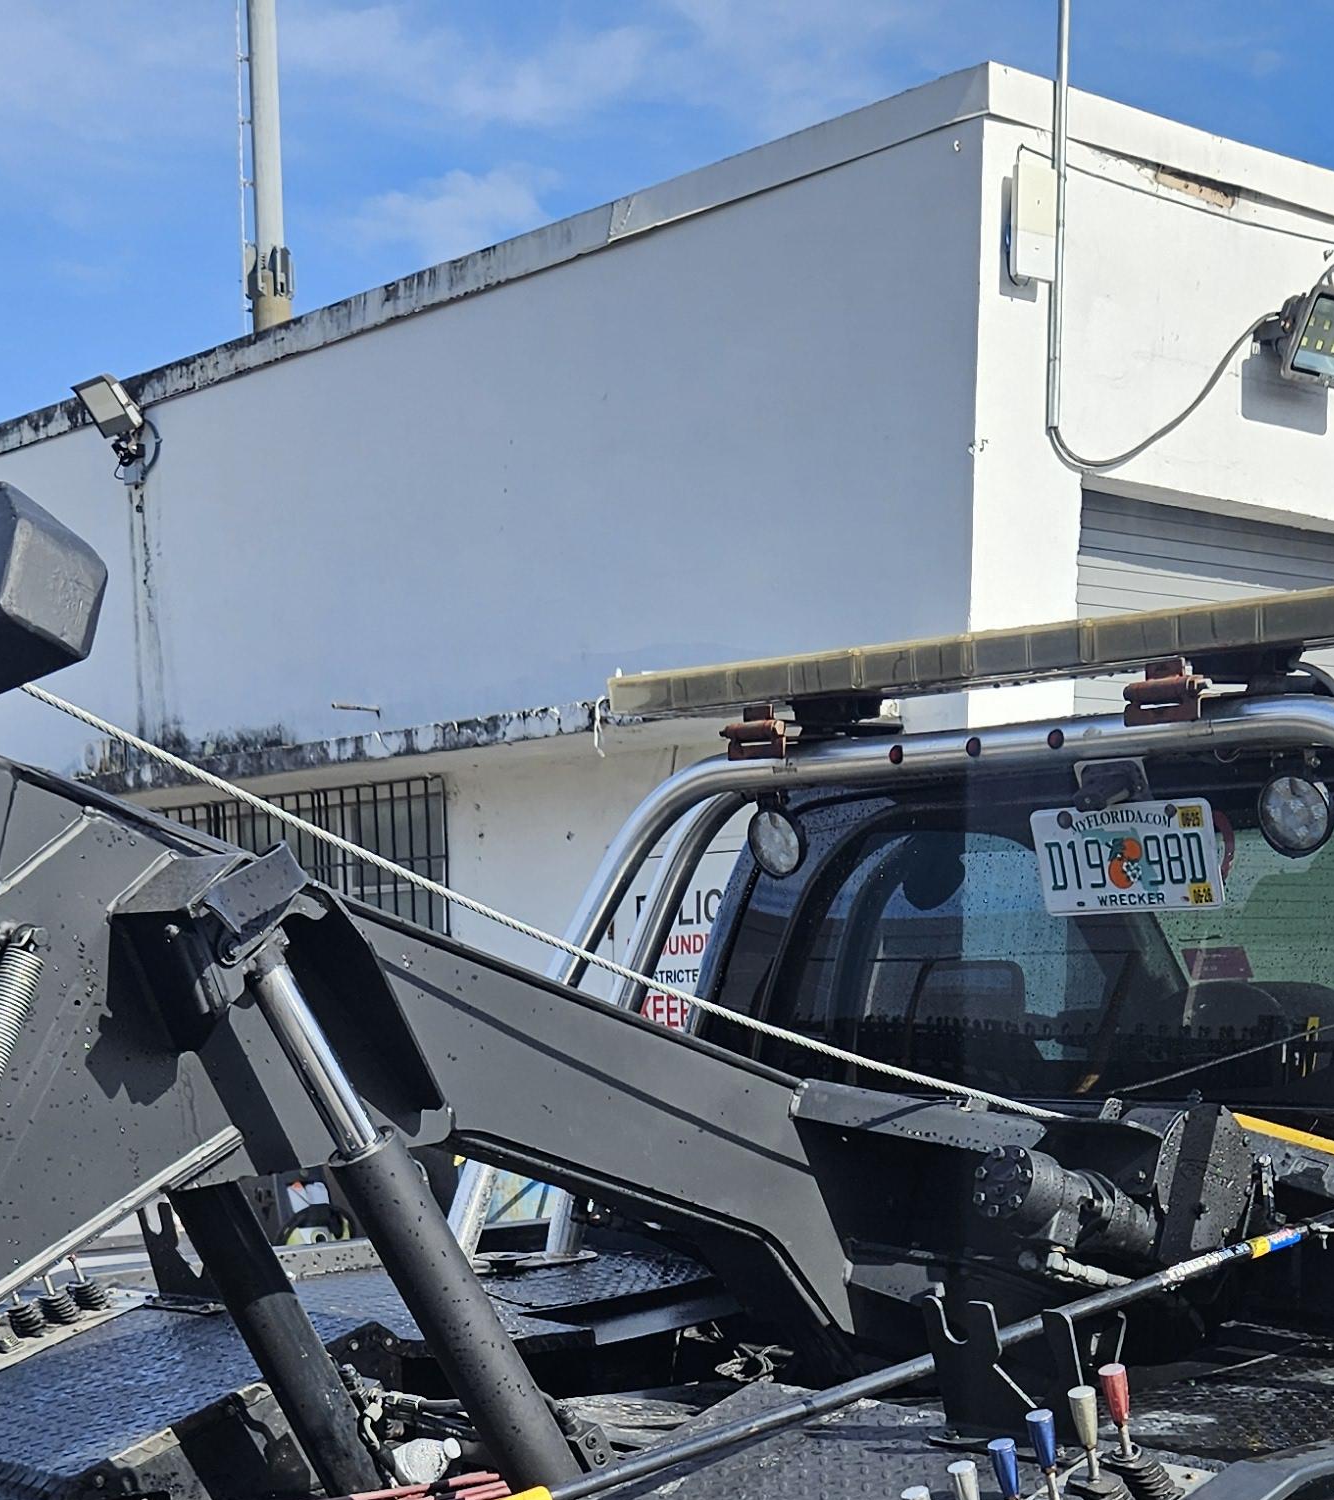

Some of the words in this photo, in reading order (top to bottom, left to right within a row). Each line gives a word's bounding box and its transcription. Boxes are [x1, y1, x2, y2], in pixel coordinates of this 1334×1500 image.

[1071, 808, 1172, 836] MYFLORIDA.COM
[1044, 839, 1107, 891] D19
[1142, 832, 1208, 886] 98D
[1097, 892, 1166, 907] WRECKER
